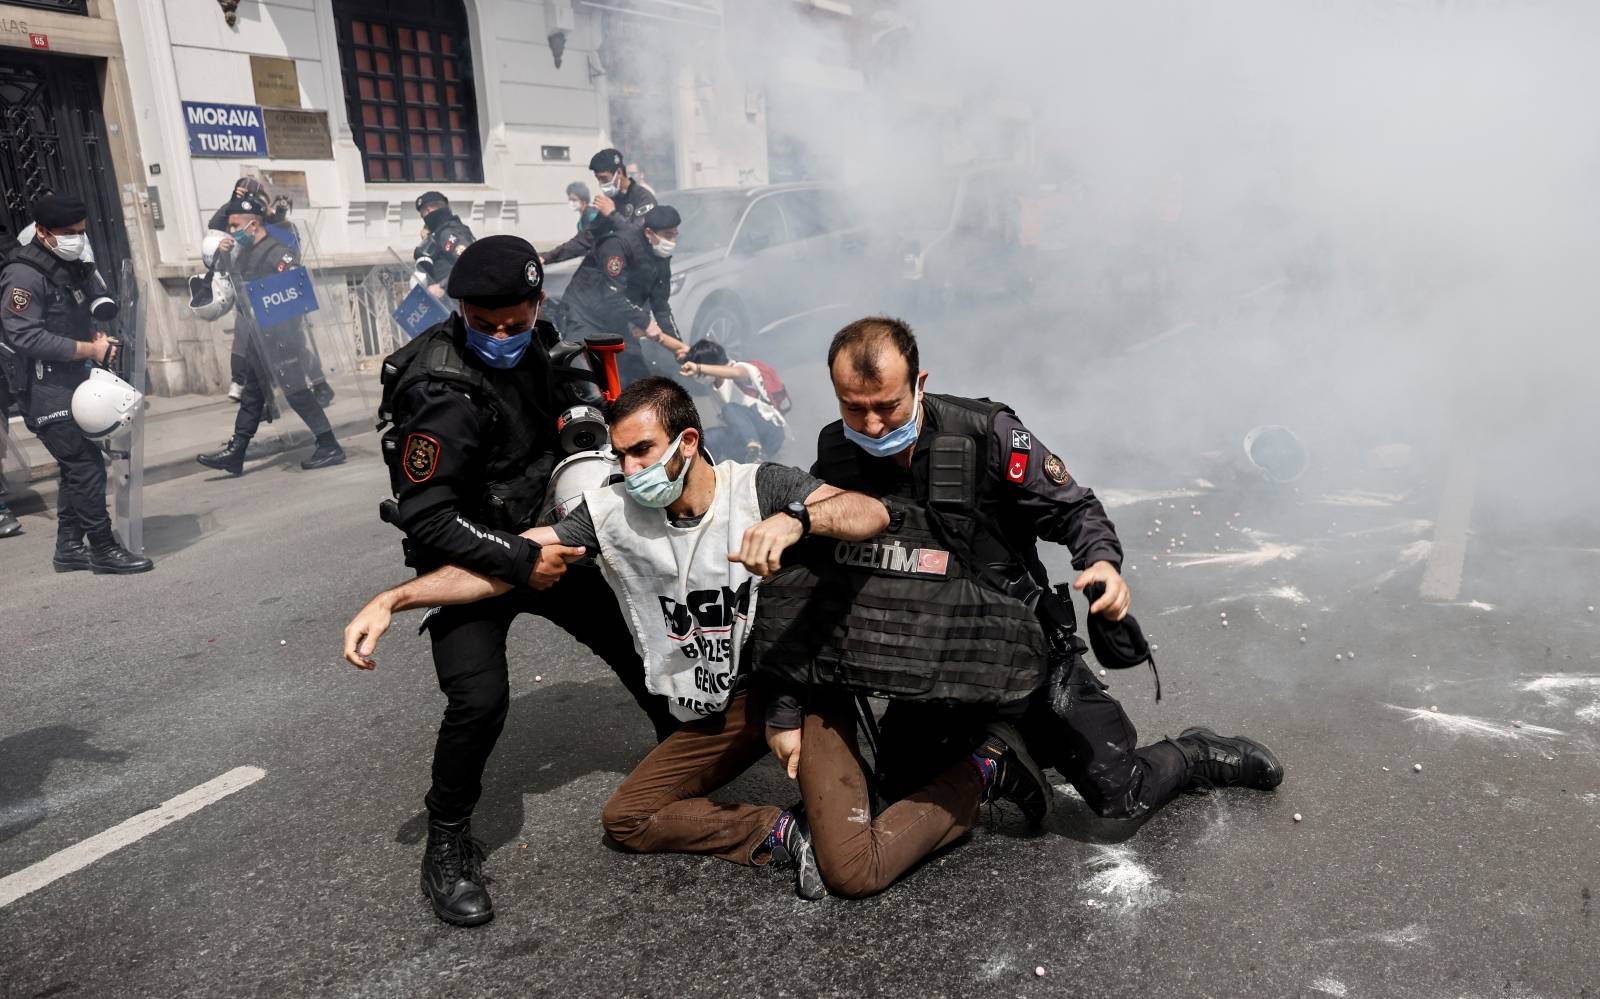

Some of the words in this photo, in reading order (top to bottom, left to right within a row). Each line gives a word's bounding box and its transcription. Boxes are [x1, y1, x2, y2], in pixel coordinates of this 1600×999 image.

[34, 36, 45, 46] 65
[187, 106, 260, 127] MORAVA
[197, 129, 257, 152] TURİZM
